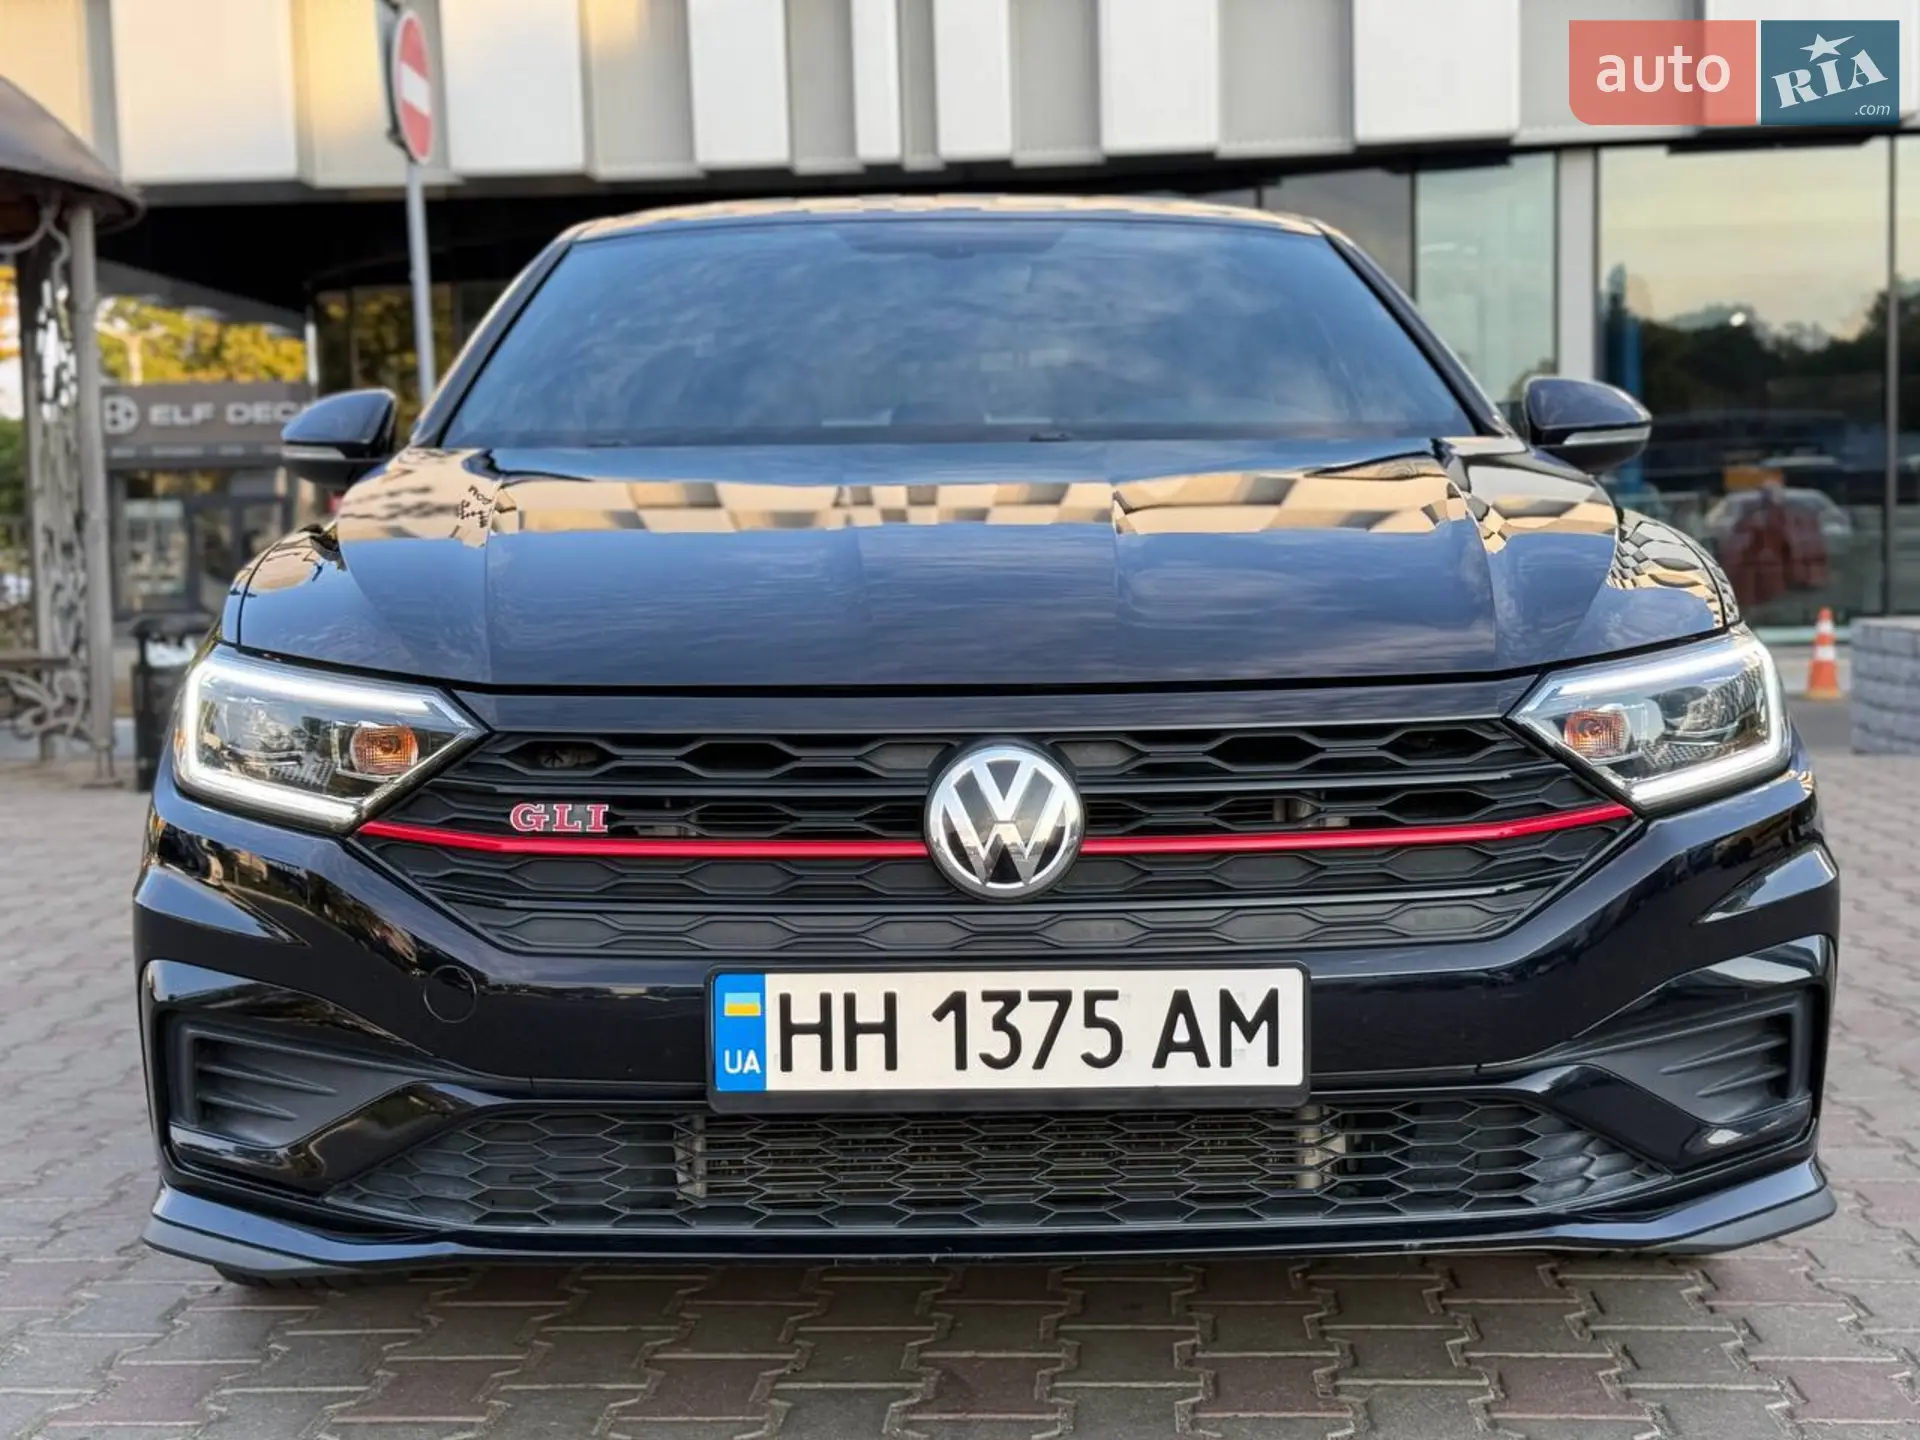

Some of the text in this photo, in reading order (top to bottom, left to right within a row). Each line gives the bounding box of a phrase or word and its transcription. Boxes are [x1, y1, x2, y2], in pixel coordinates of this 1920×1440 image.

[150, 402, 307, 426] ELF DEC
[510, 803, 609, 832] GLI
[779, 987, 1280, 1073] HH 1375 AM
[724, 1050, 761, 1075] UA
